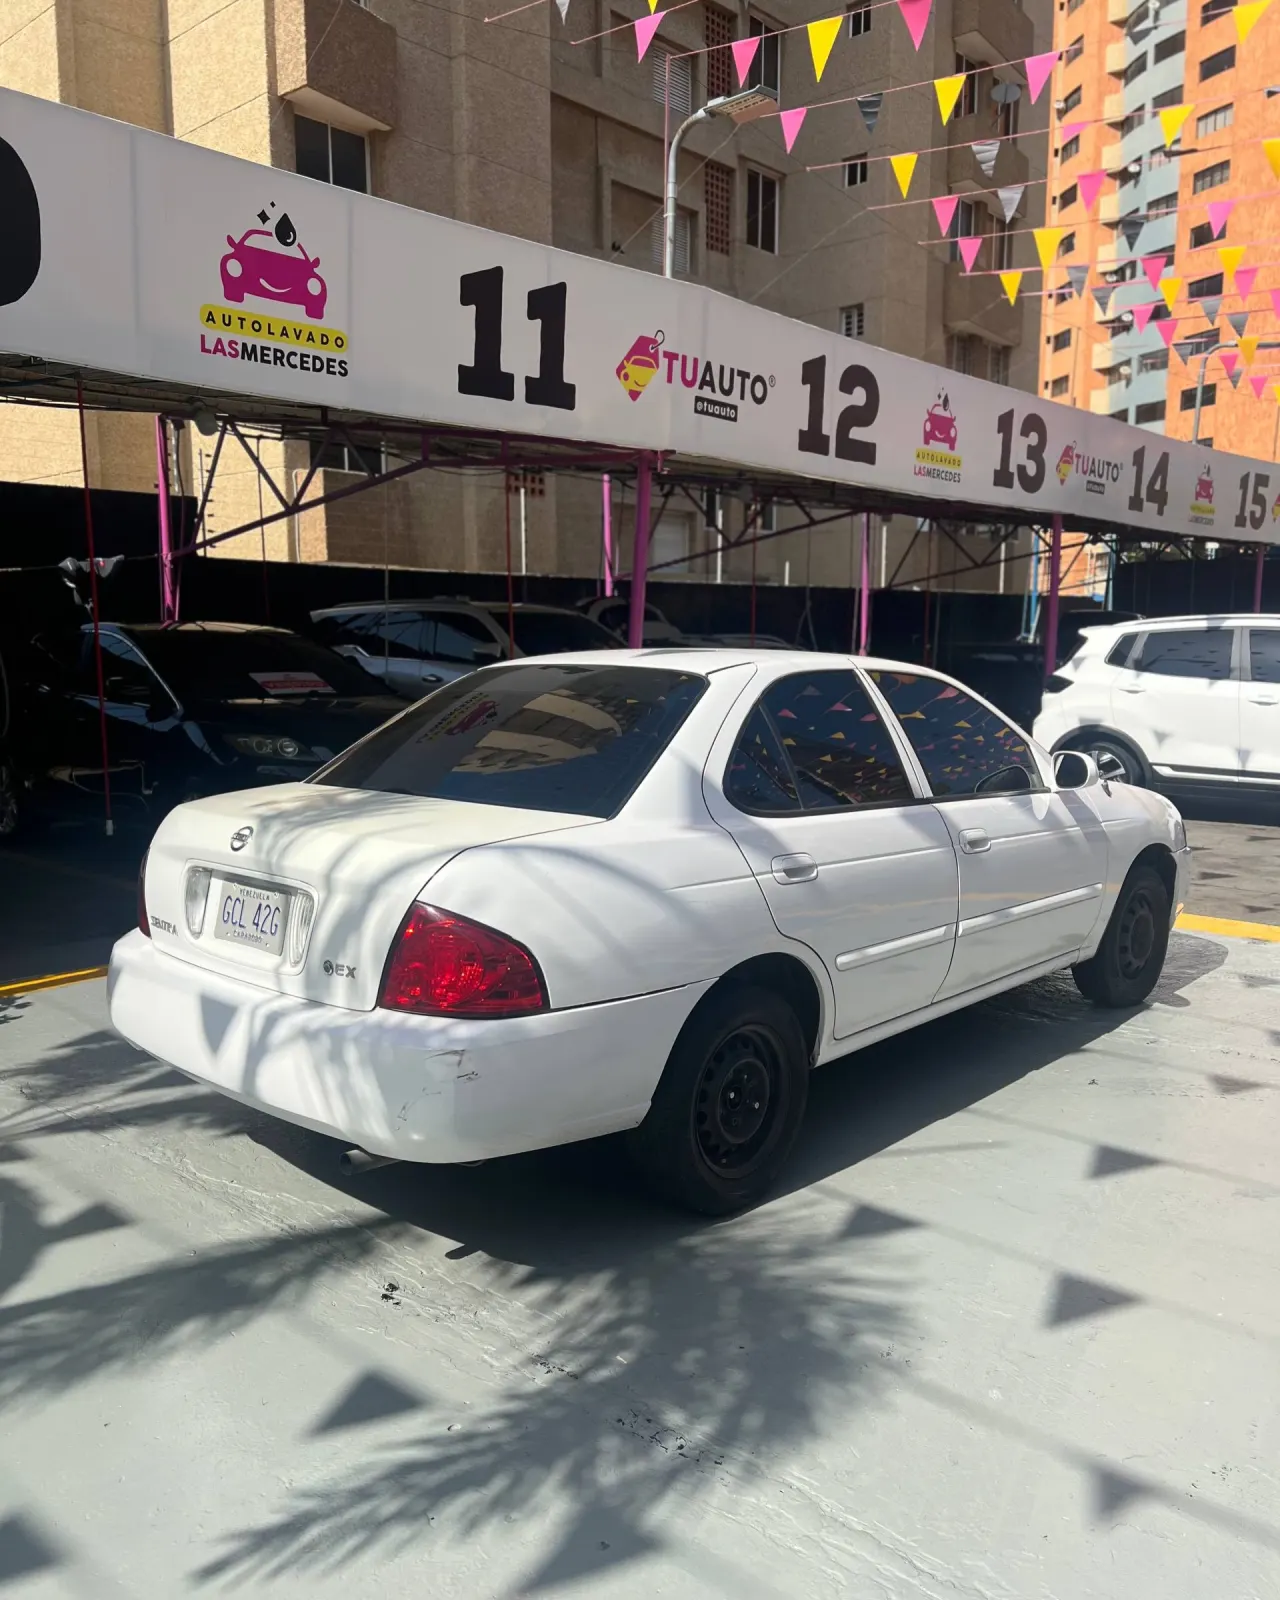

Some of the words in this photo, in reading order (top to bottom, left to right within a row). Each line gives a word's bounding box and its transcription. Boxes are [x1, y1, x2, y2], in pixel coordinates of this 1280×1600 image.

[205, 311, 345, 349] AUTOLAVADO
[458, 266, 577, 410] 11
[200, 334, 349, 377] LASMERCEDES
[696, 401, 736, 419] @tuauto
[798, 354, 880, 466] 12
[916, 451, 962, 467] AUTOLAVADO
[993, 408, 1048, 494] 13
[1128, 445, 1170, 517] 14
[1234, 471, 1270, 530] 15
[222, 895, 246, 928] GCL
[252, 902, 281, 936] 42G
[239, 888, 270, 901] VENEZUELA
[335, 964, 357, 979] EX
